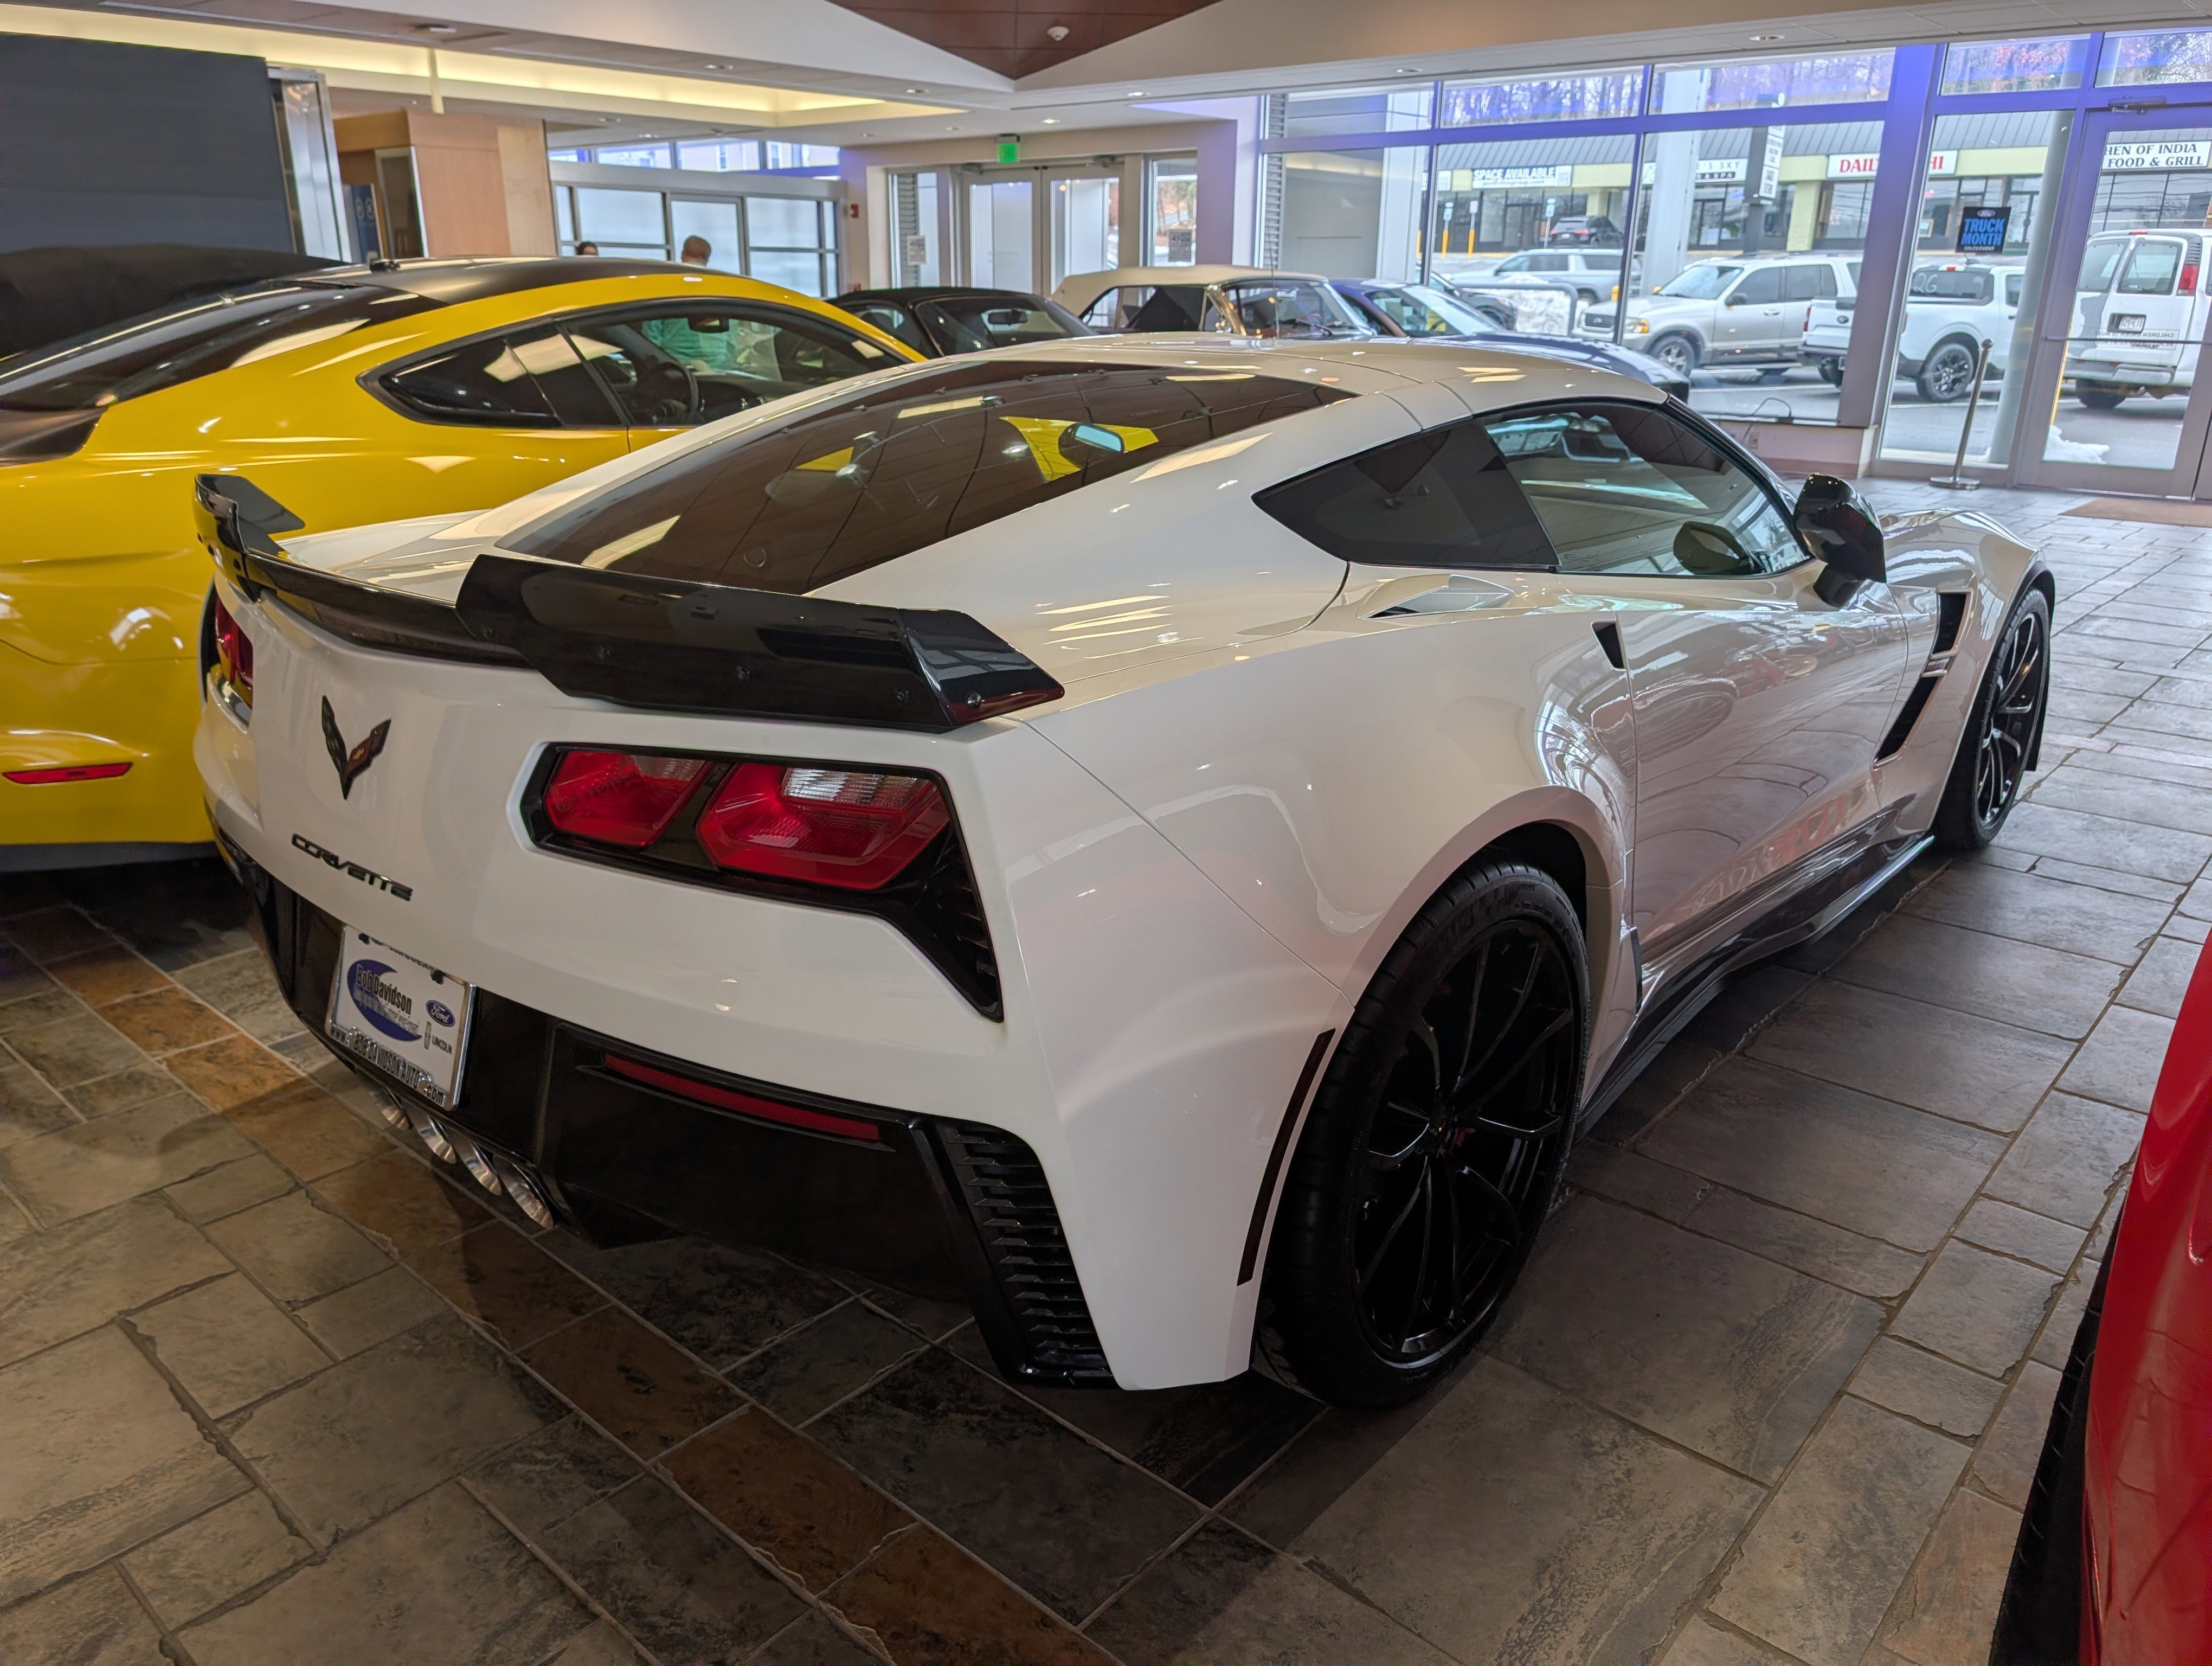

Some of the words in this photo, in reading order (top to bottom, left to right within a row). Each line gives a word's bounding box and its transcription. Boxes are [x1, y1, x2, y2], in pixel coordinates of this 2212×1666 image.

[2136, 145, 2155, 155] OF
[2158, 143, 2197, 154] INDIA
[1839, 158, 1880, 173] DAIL
[2107, 158, 2145, 168] FOOD
[2149, 157, 2160, 166] &
[2165, 156, 2204, 166] GRILL
[1473, 169, 1504, 180] SPACE
[1504, 166, 1555, 178] AVAILABLE
[1964, 219, 2005, 232] TRUCK
[1960, 233, 2002, 245] MONTH
[291, 832, 413, 902] CORVETTE
[357, 964, 374, 990] Bob
[373, 974, 412, 1016] Davidson
[431, 1003, 450, 1023] Ford
[432, 1034, 452, 1055] LINCOLN
